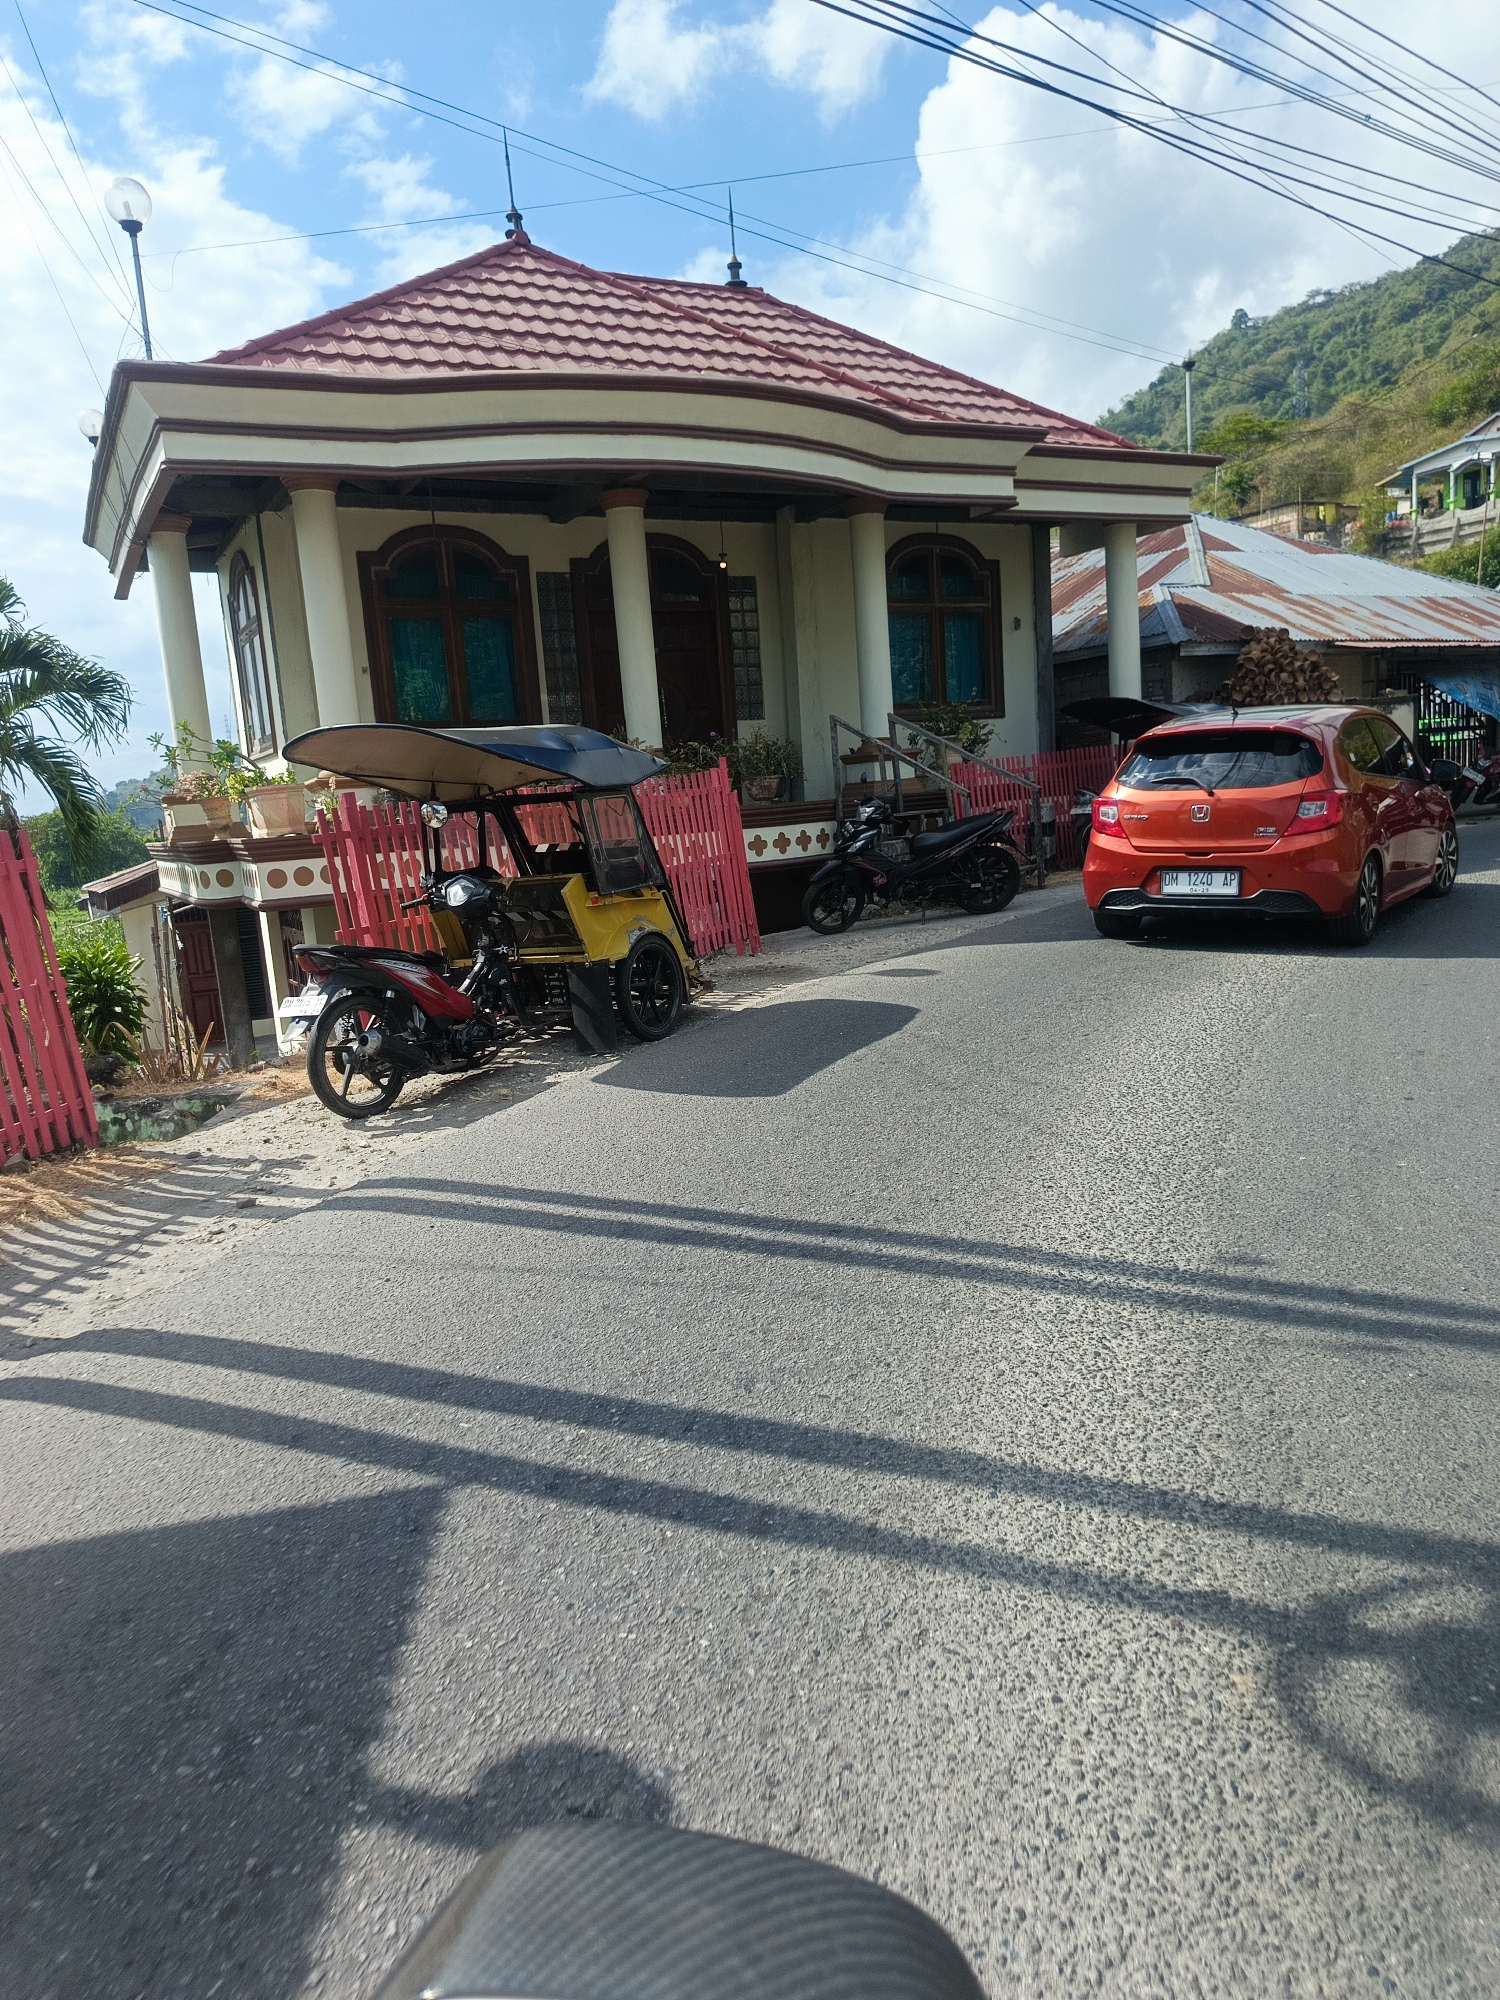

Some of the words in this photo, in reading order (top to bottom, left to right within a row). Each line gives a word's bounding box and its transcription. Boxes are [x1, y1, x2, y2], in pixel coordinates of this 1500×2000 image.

[1164, 872, 1179, 887] DM
[1187, 872, 1213, 887] 1240
[1222, 872, 1236, 887] AP
